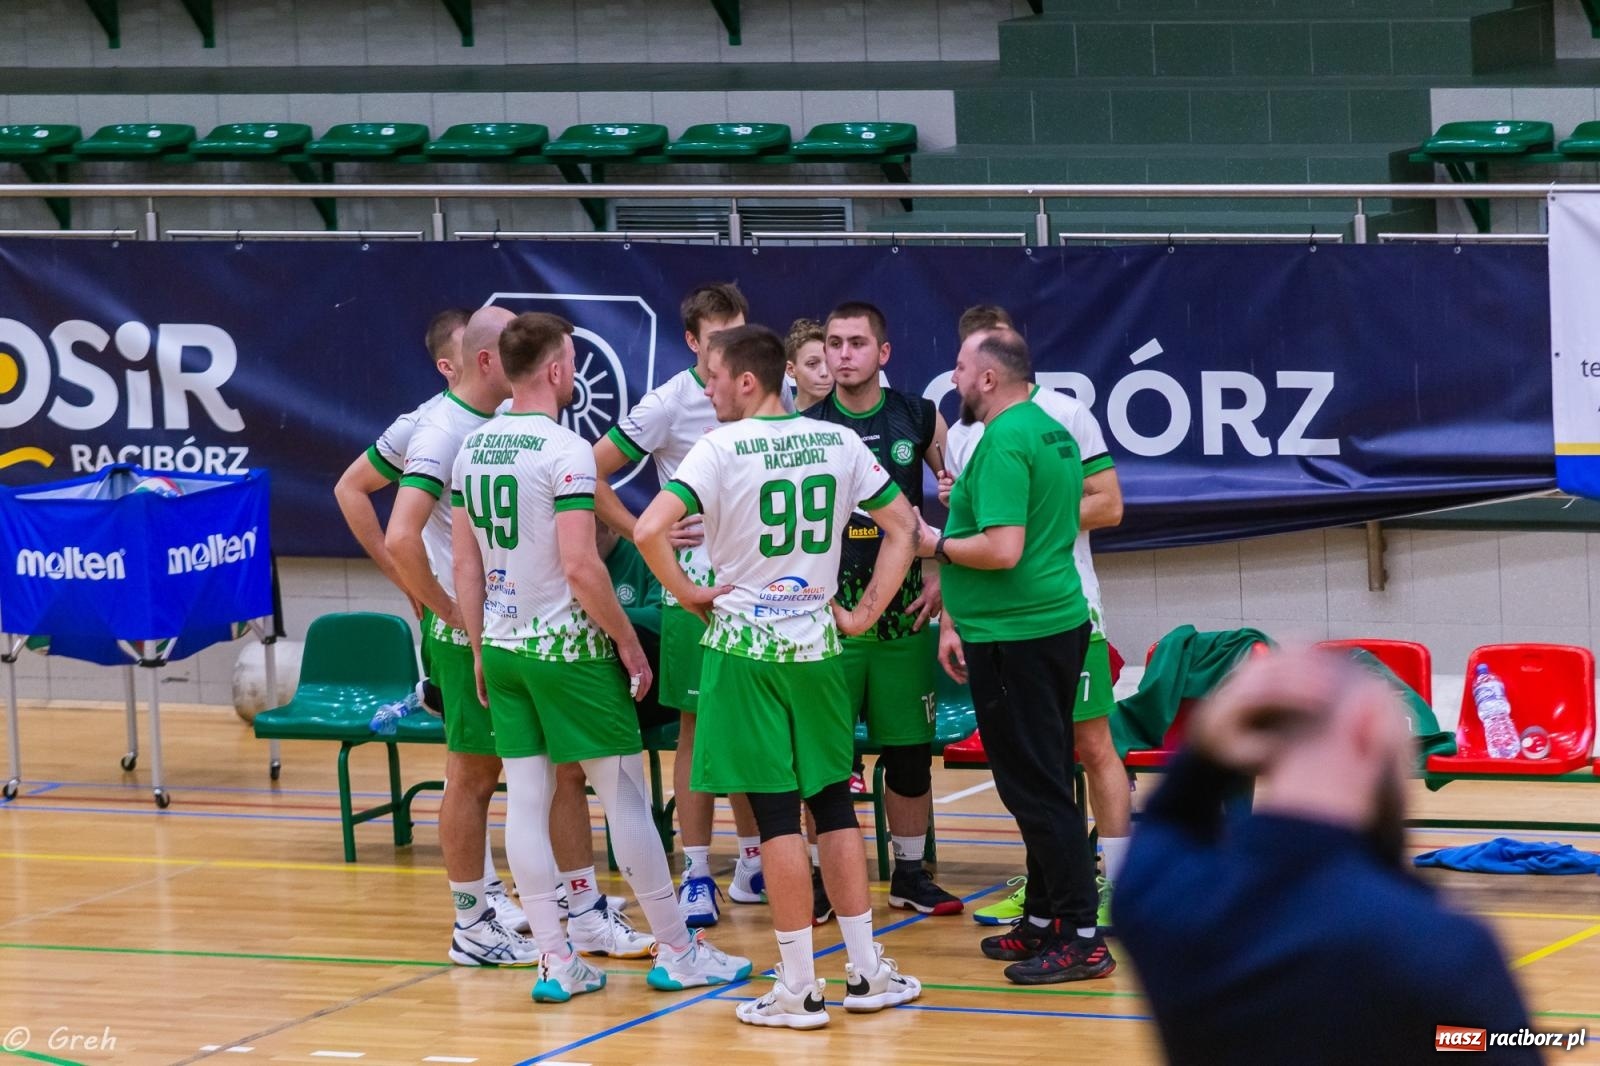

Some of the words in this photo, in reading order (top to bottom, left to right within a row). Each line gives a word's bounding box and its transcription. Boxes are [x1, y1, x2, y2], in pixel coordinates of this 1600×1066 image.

[70, 435, 249, 475] RACIBÓRZ
[734, 438, 769, 455] KLUB
[771, 432, 844, 452] SIATKARSKI
[465, 474, 519, 550] 49
[759, 473, 837, 558] 99
[16, 547, 126, 580] molten
[166, 527, 257, 575] molten
[571, 878, 590, 891] R
